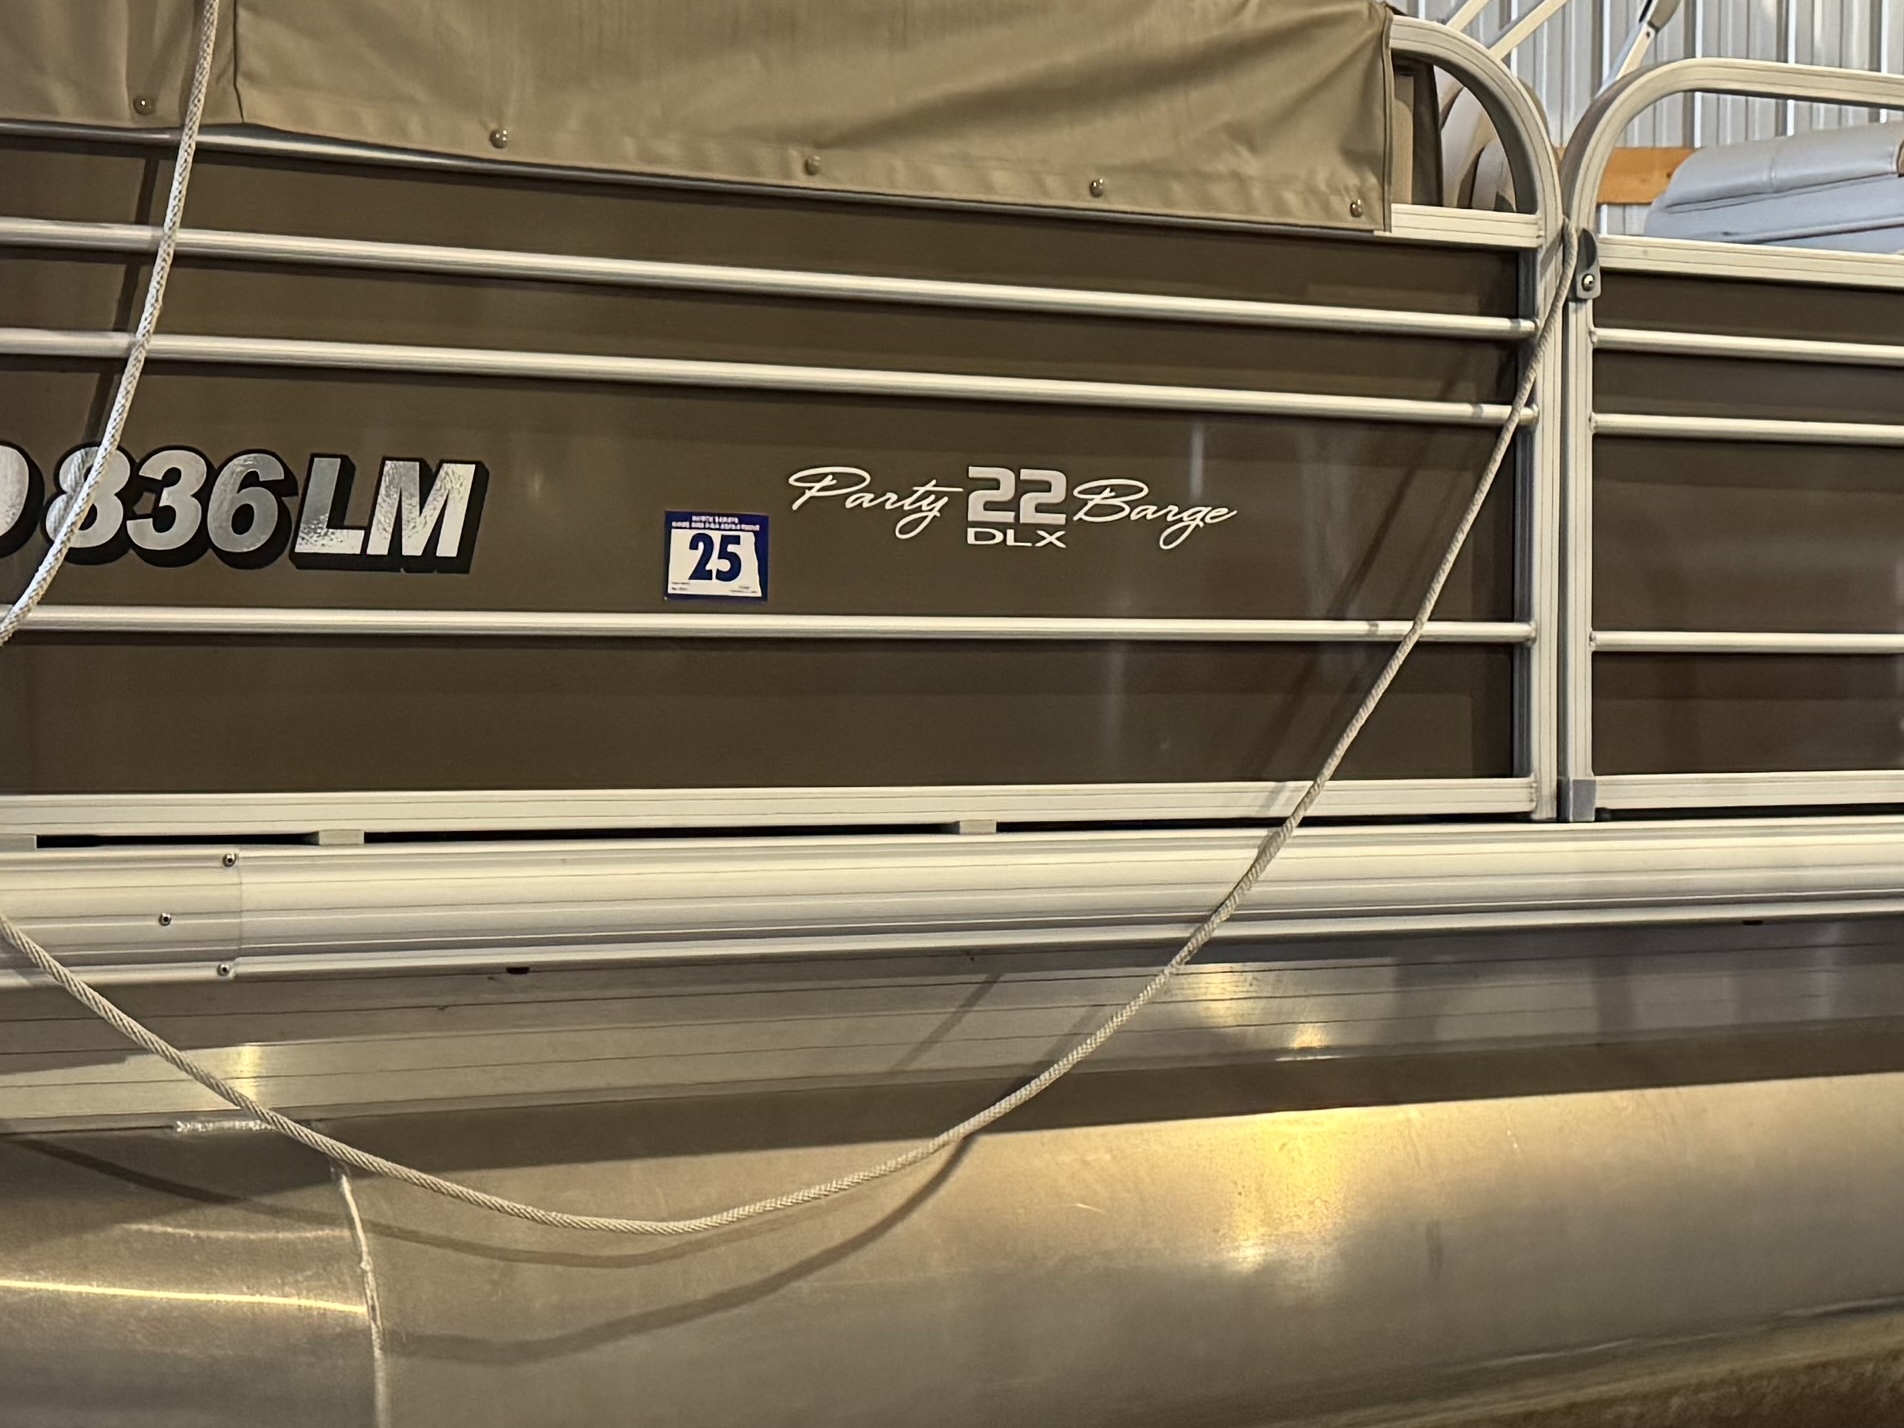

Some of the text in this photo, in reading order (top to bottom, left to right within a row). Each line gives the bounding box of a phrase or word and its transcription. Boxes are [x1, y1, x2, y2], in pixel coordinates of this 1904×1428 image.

[41, 443, 294, 564] 836
[293, 454, 486, 573] LM
[788, 465, 1238, 550] Party 22 Barge
[966, 527, 1067, 549] DLX
[687, 532, 743, 583] 25
